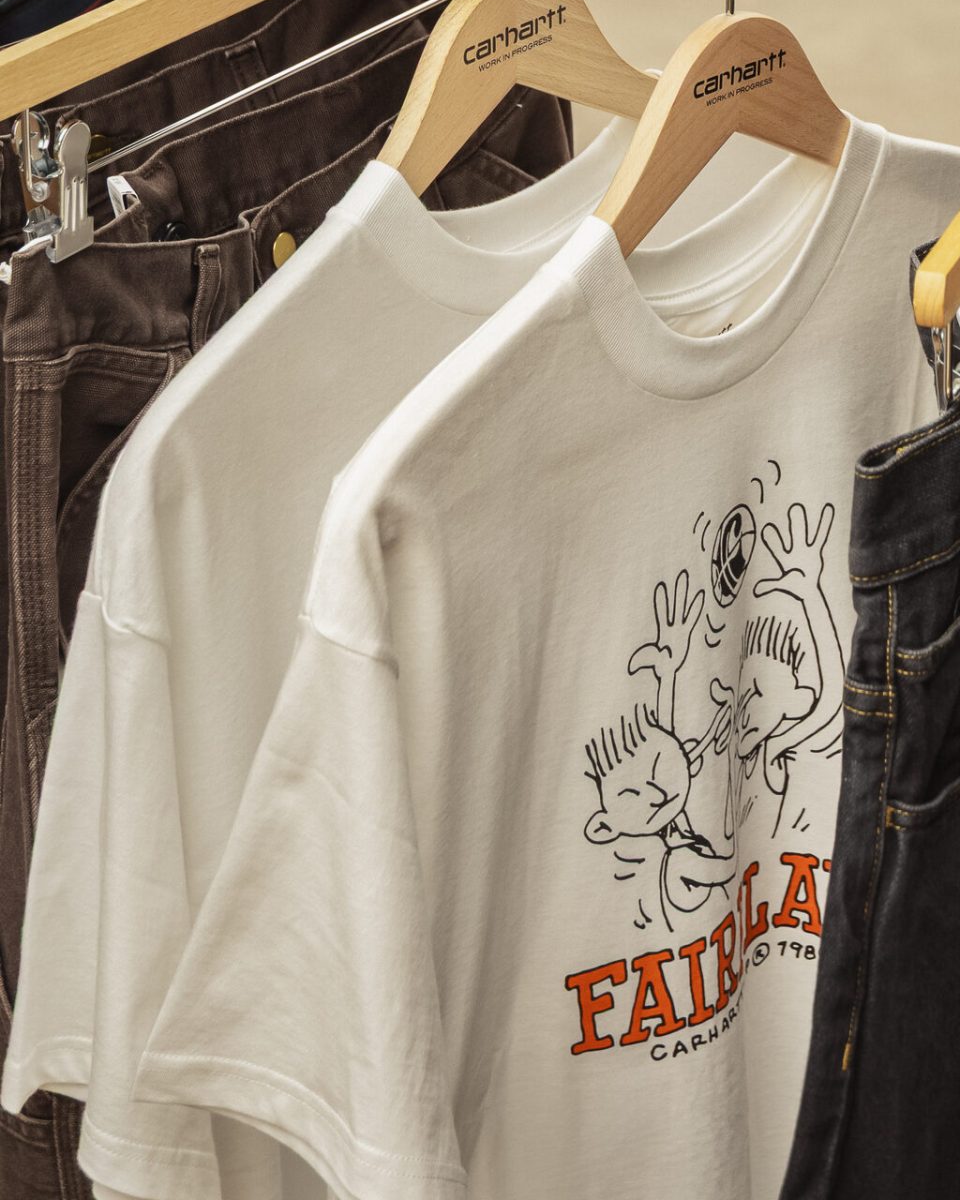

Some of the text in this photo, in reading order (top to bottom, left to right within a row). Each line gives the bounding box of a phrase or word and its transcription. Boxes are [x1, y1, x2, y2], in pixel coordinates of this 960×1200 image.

[463, 4, 567, 66] carhartt
[478, 34, 553, 72] WORK IN PROGRESS
[693, 48, 786, 100] carhartt
[705, 76, 774, 107] WORK IN PROGRESS
[565, 851, 832, 1056] FAIRLA
